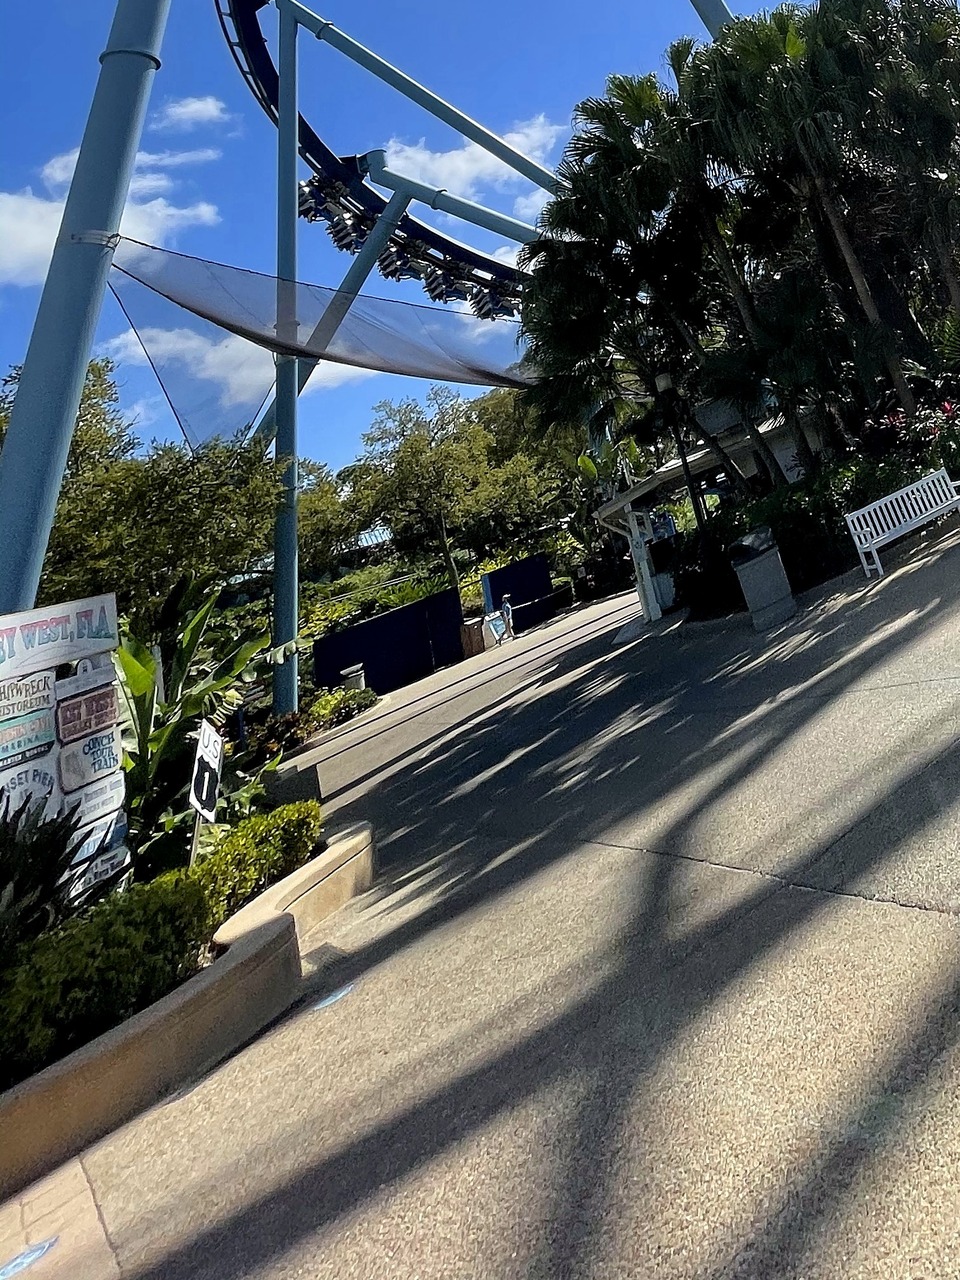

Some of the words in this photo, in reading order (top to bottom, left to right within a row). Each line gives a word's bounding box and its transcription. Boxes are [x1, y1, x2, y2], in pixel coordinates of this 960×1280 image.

[1, 734, 39, 753] MARINA
[83, 731, 115, 755] CONCH
[91, 745, 114, 761] TOUR
[91, 753, 119, 773] TRAIN
[201, 771, 209, 801] 1
